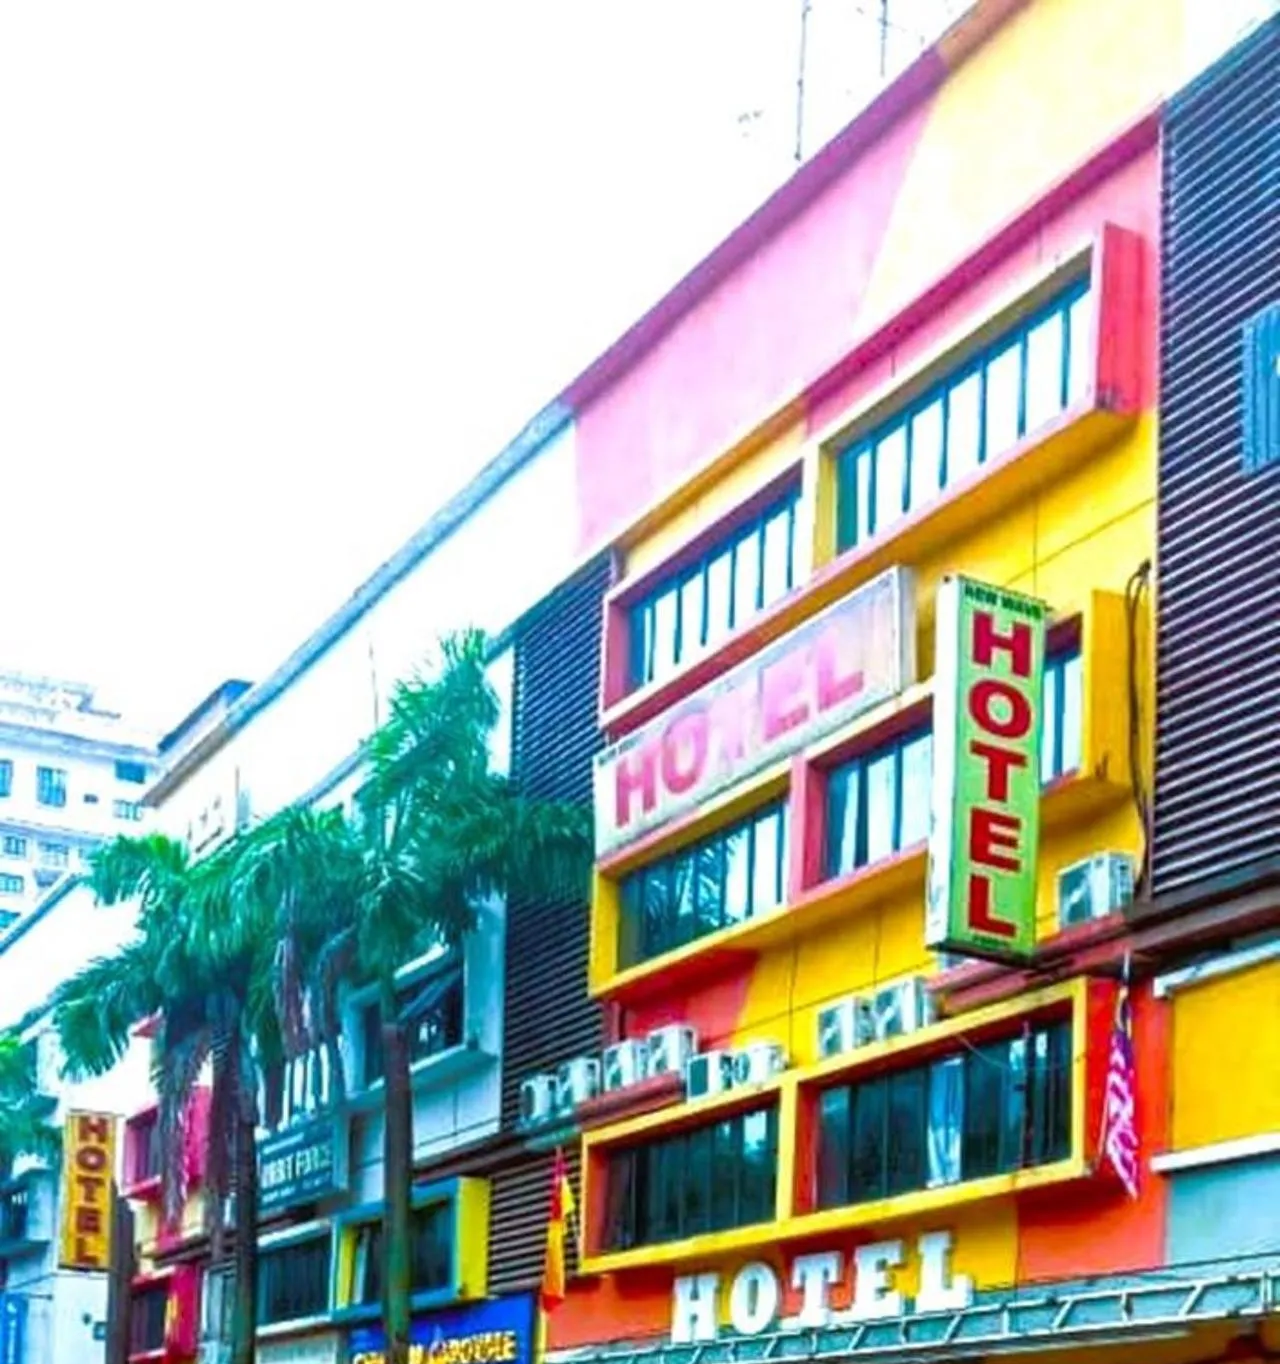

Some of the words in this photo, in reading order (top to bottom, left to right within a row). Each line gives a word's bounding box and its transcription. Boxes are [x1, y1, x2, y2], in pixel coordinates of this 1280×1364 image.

[615, 624, 864, 829] HOTEL
[967, 609, 1032, 938] HOTEL
[74, 1115, 108, 1265] HOTEL
[671, 1230, 973, 1342] HOTEL
